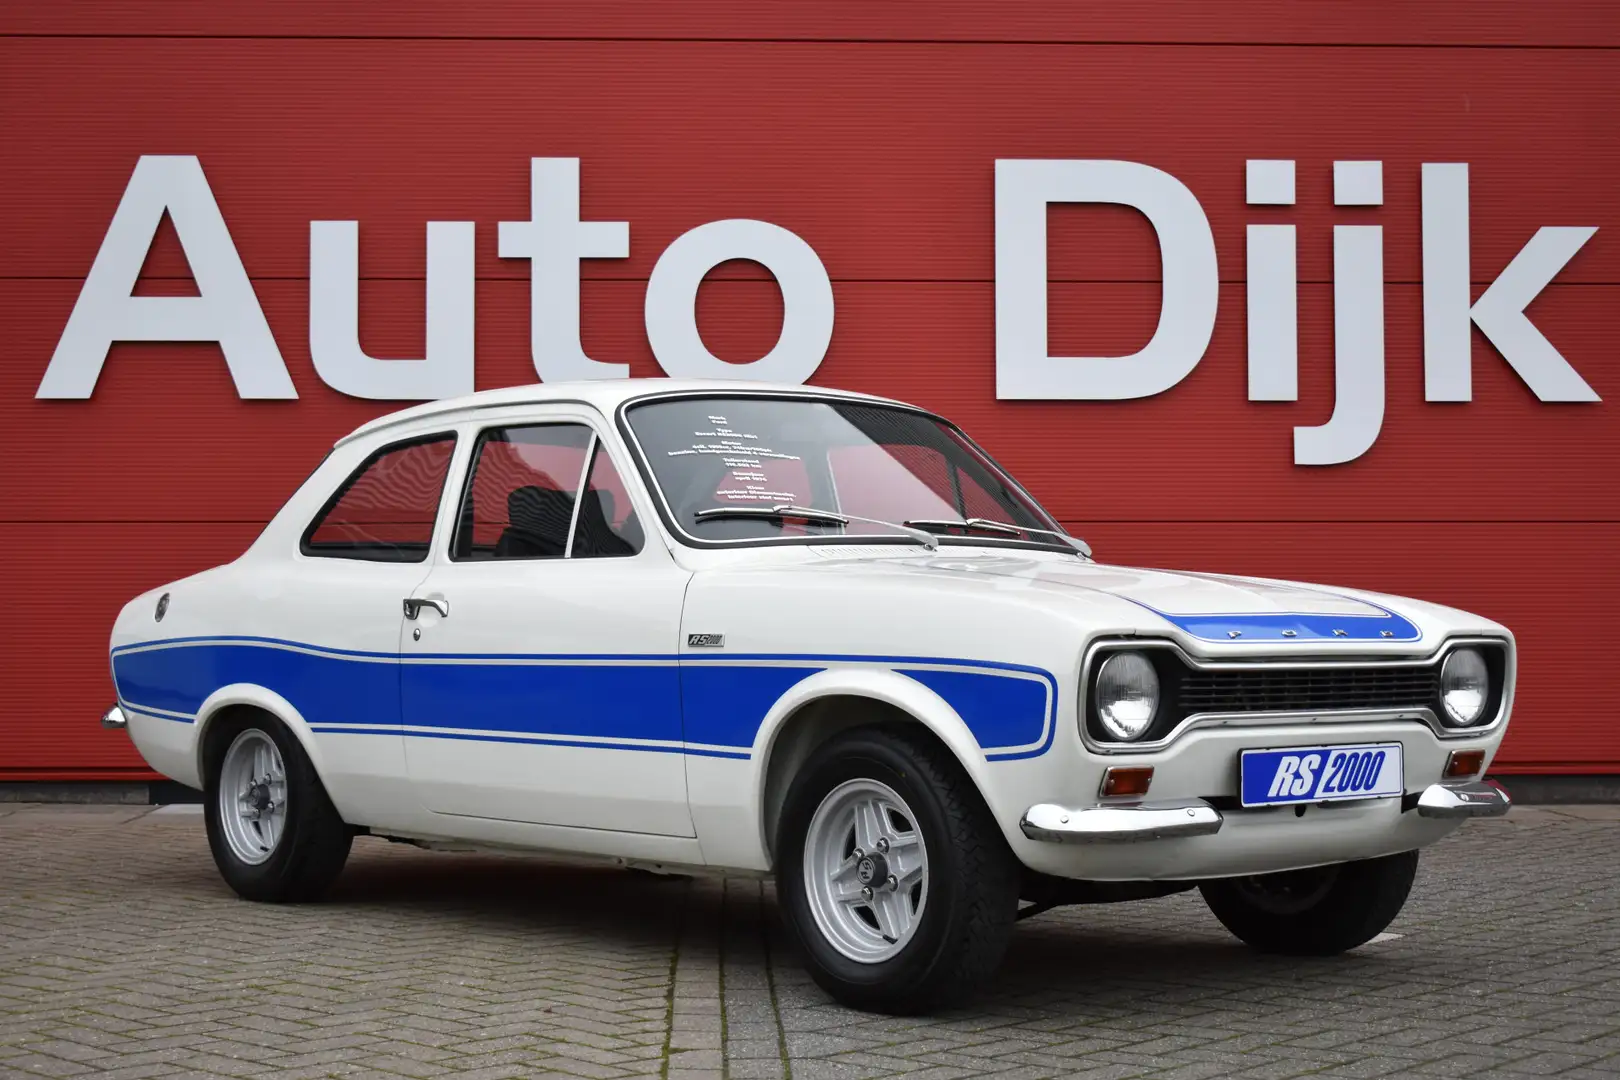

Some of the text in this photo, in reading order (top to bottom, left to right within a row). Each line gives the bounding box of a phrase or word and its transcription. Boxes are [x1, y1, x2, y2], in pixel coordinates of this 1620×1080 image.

[34, 154, 1602, 465] Auto Dijk
[1267, 750, 1386, 798] RS 2000
